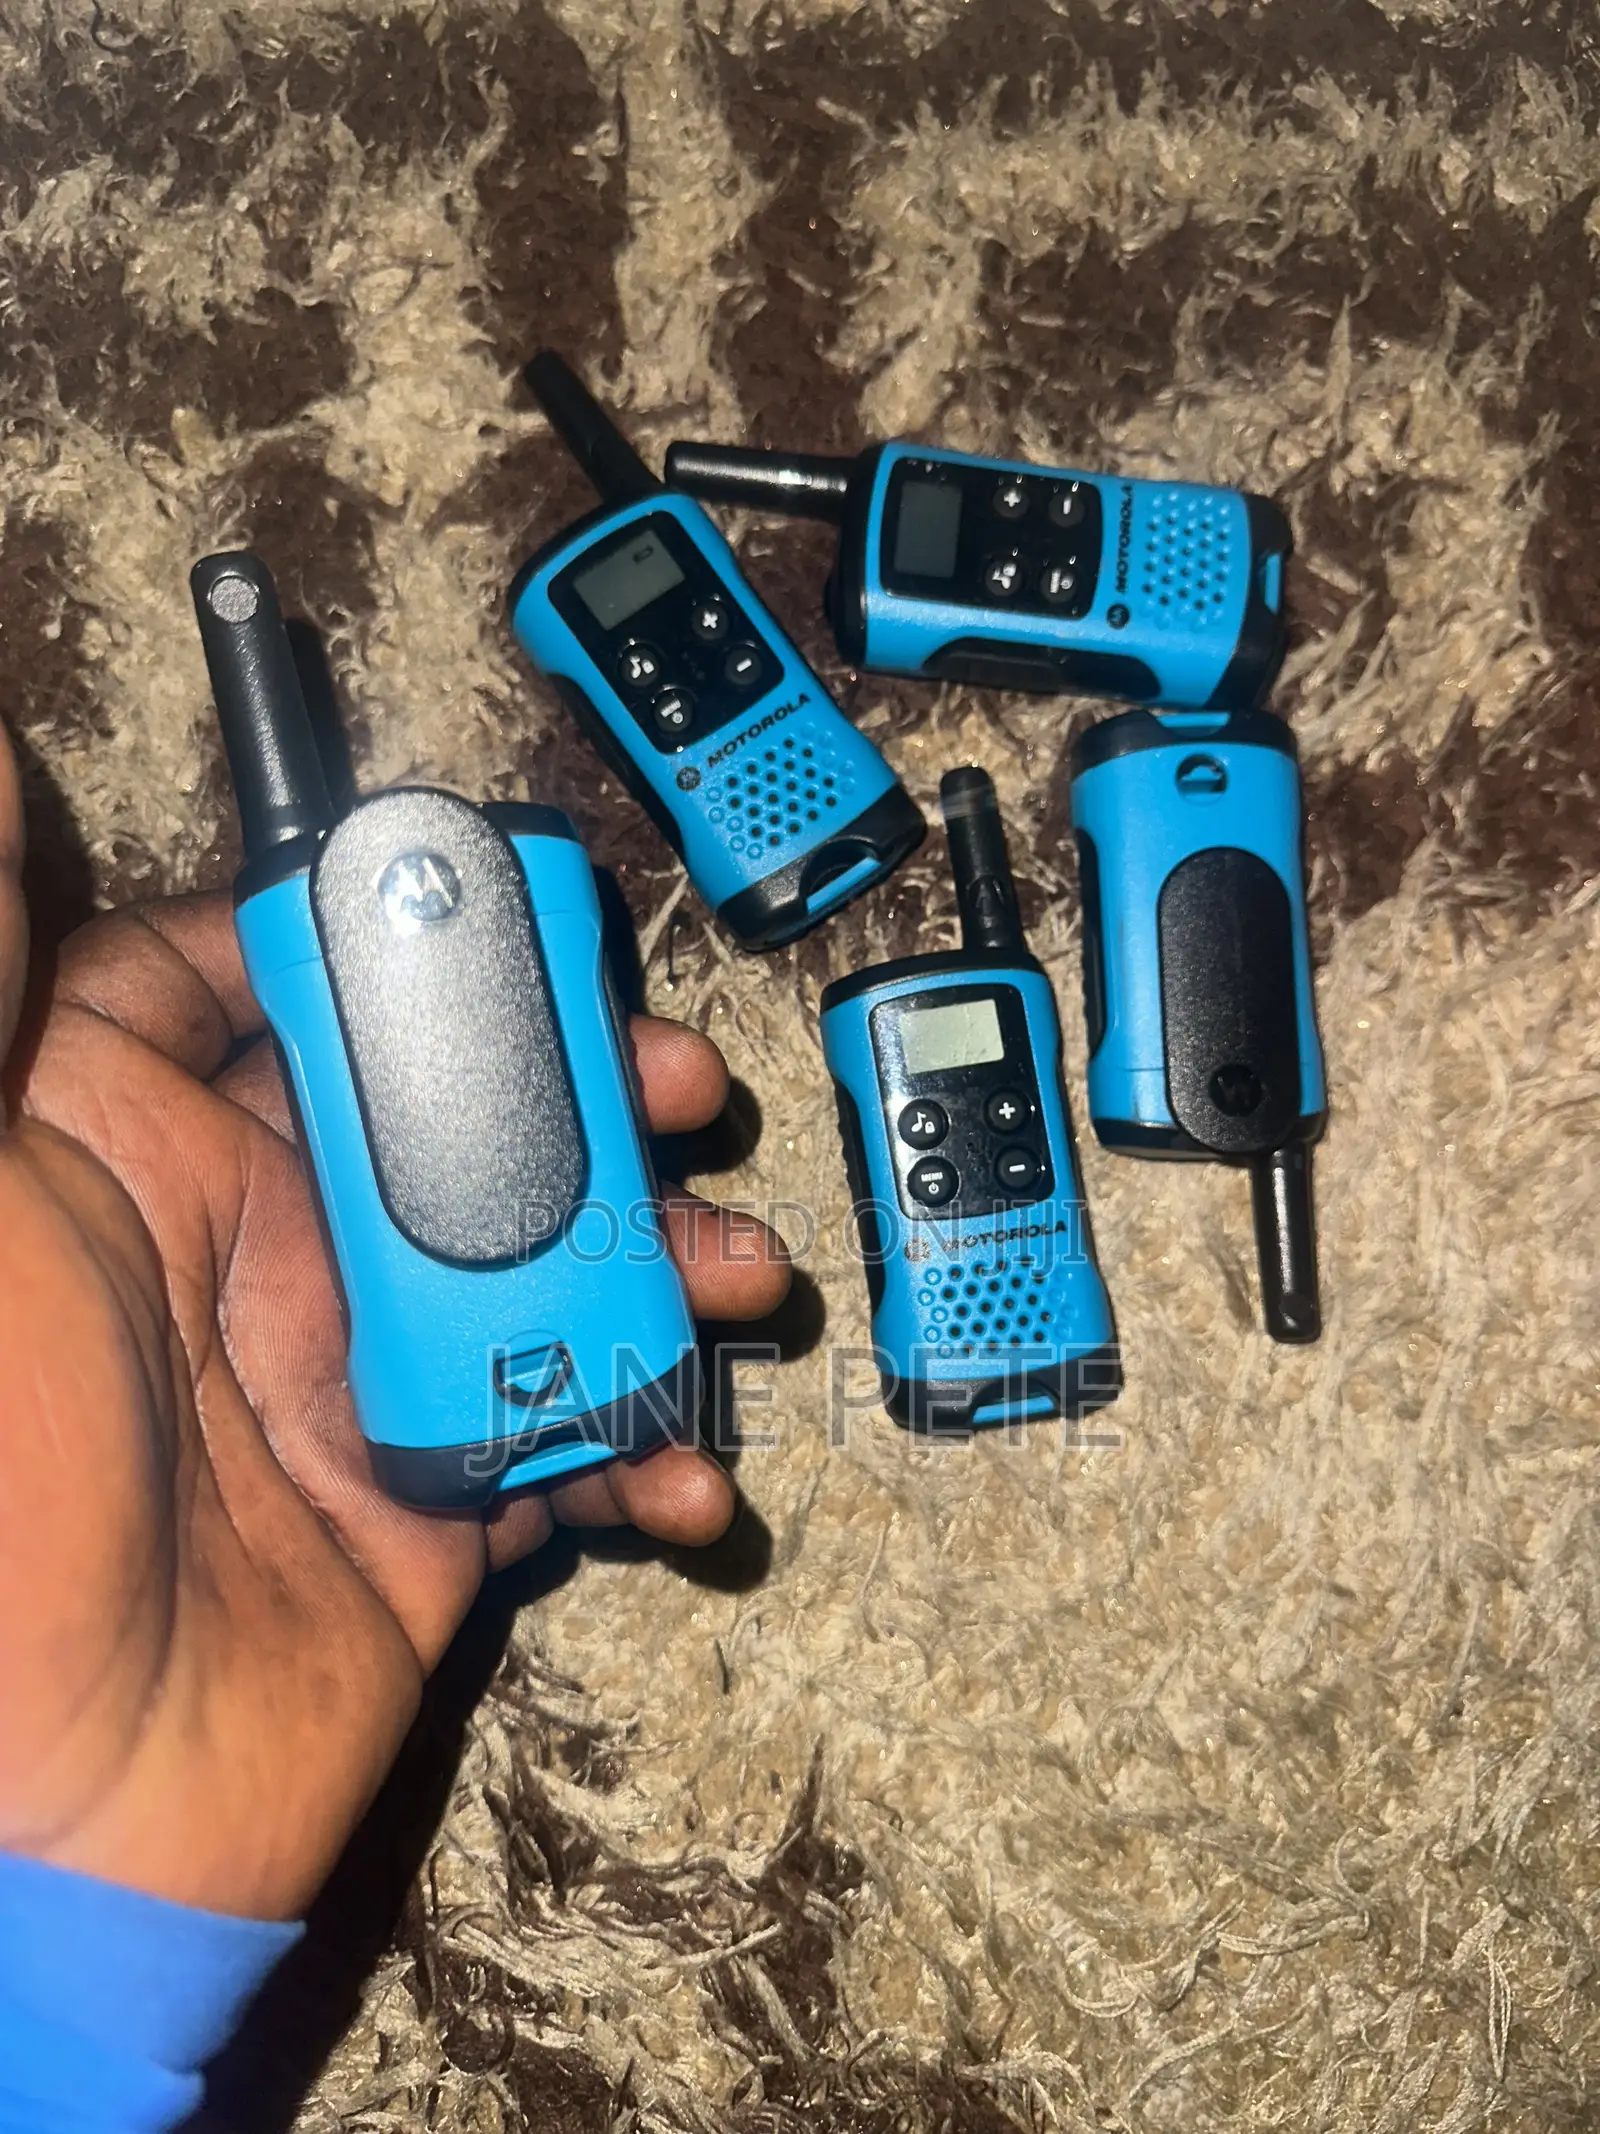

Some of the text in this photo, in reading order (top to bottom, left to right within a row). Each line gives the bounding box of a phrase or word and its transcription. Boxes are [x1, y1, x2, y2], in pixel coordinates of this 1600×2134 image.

[1116, 484, 1134, 594] MOTOROLA
[706, 692, 812, 768] MOTOROLA
[942, 1219, 1068, 1252] MOTOROLA
